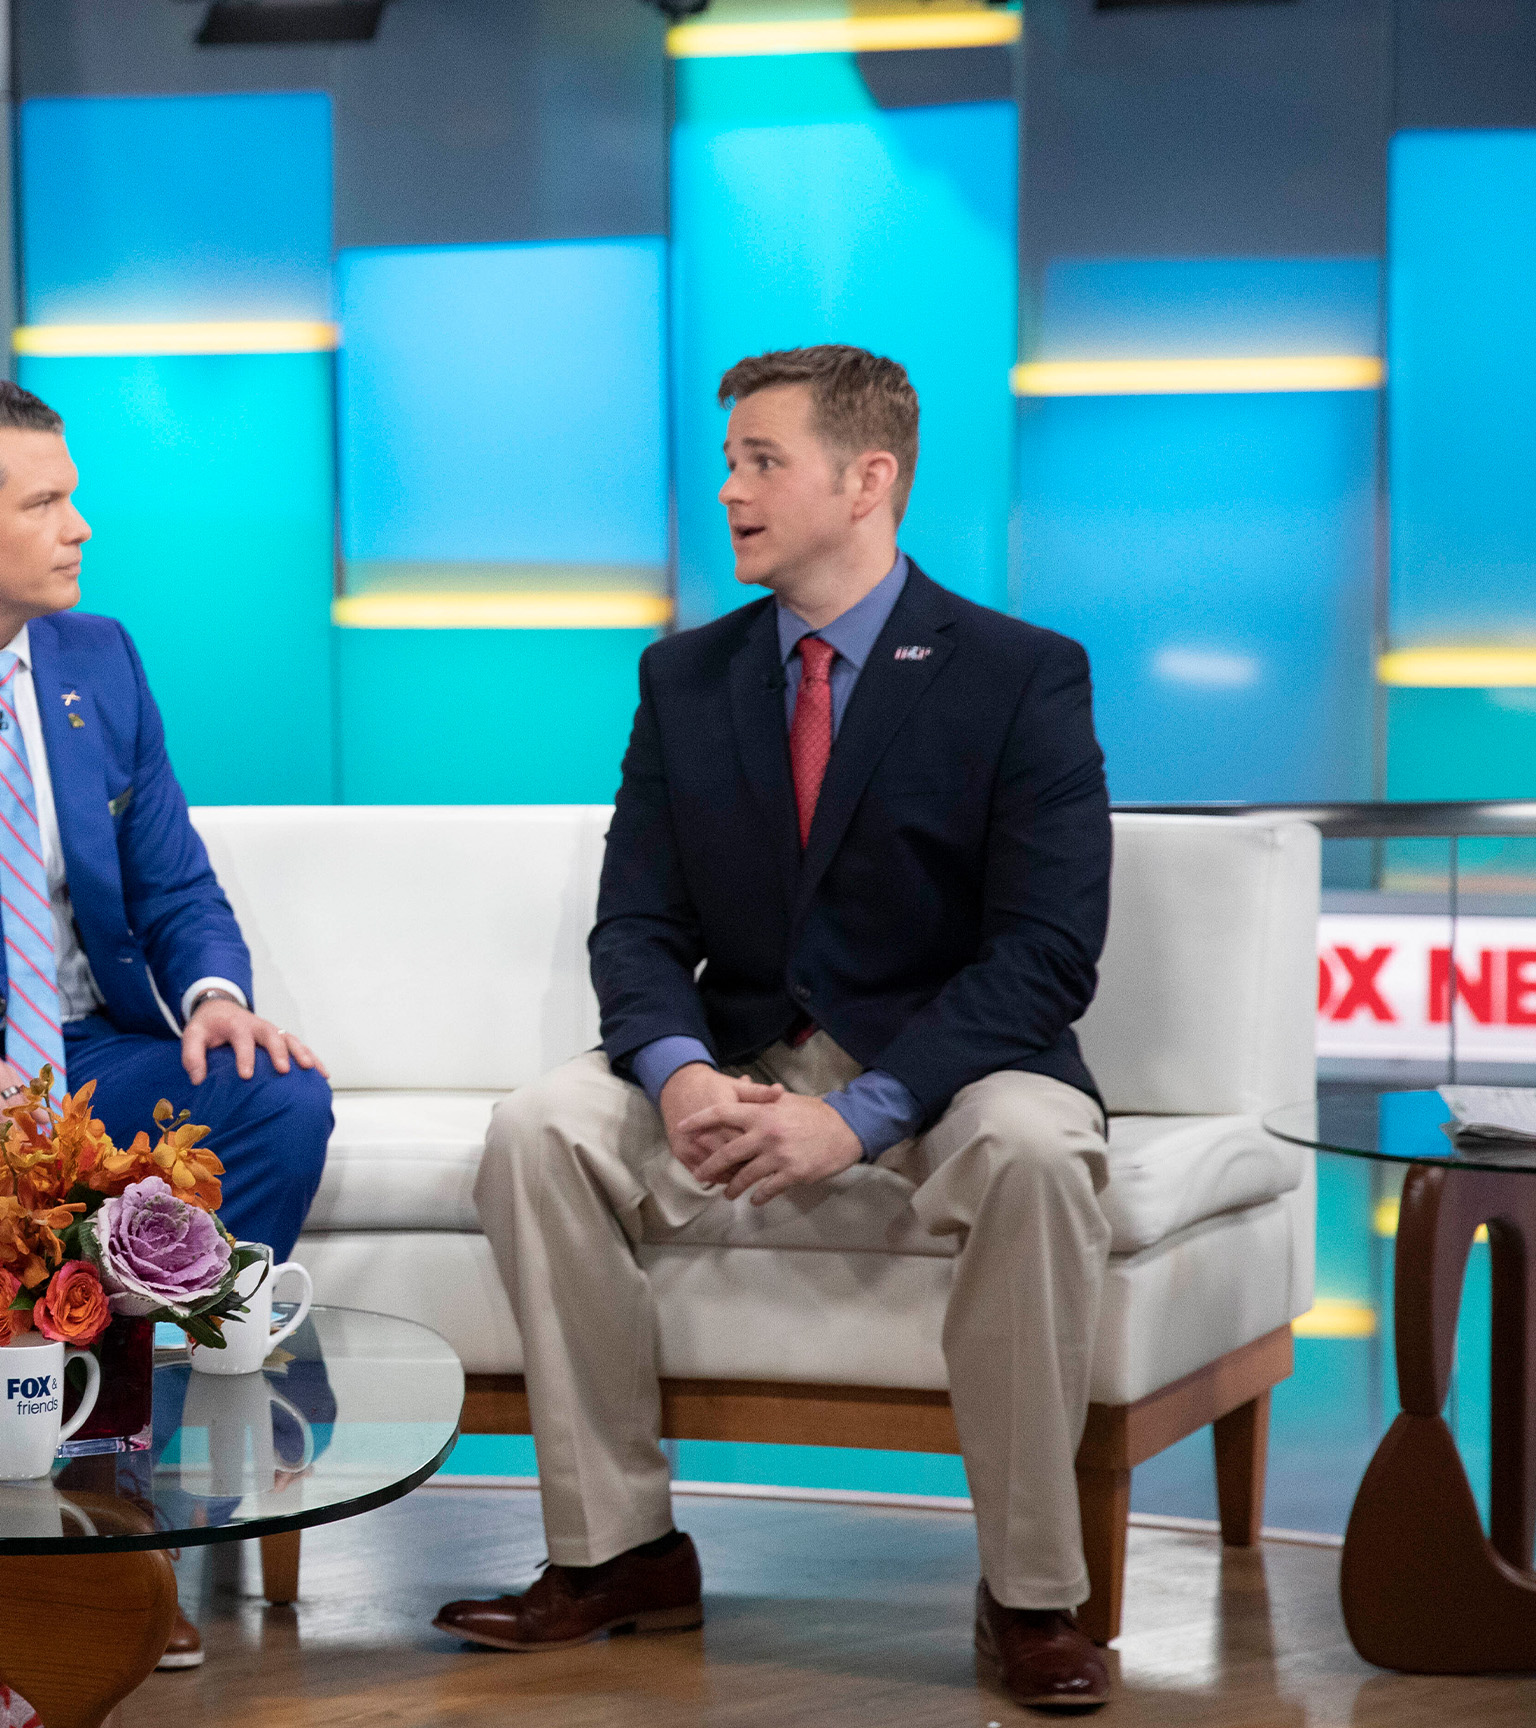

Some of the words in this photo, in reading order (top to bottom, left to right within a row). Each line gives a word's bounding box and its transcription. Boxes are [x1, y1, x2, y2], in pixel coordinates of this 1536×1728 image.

[1318, 946, 1395, 1022] X
[7, 1374, 51, 1400] FOX
[51, 1377, 57, 1390] &
[16, 1396, 58, 1415] friends
